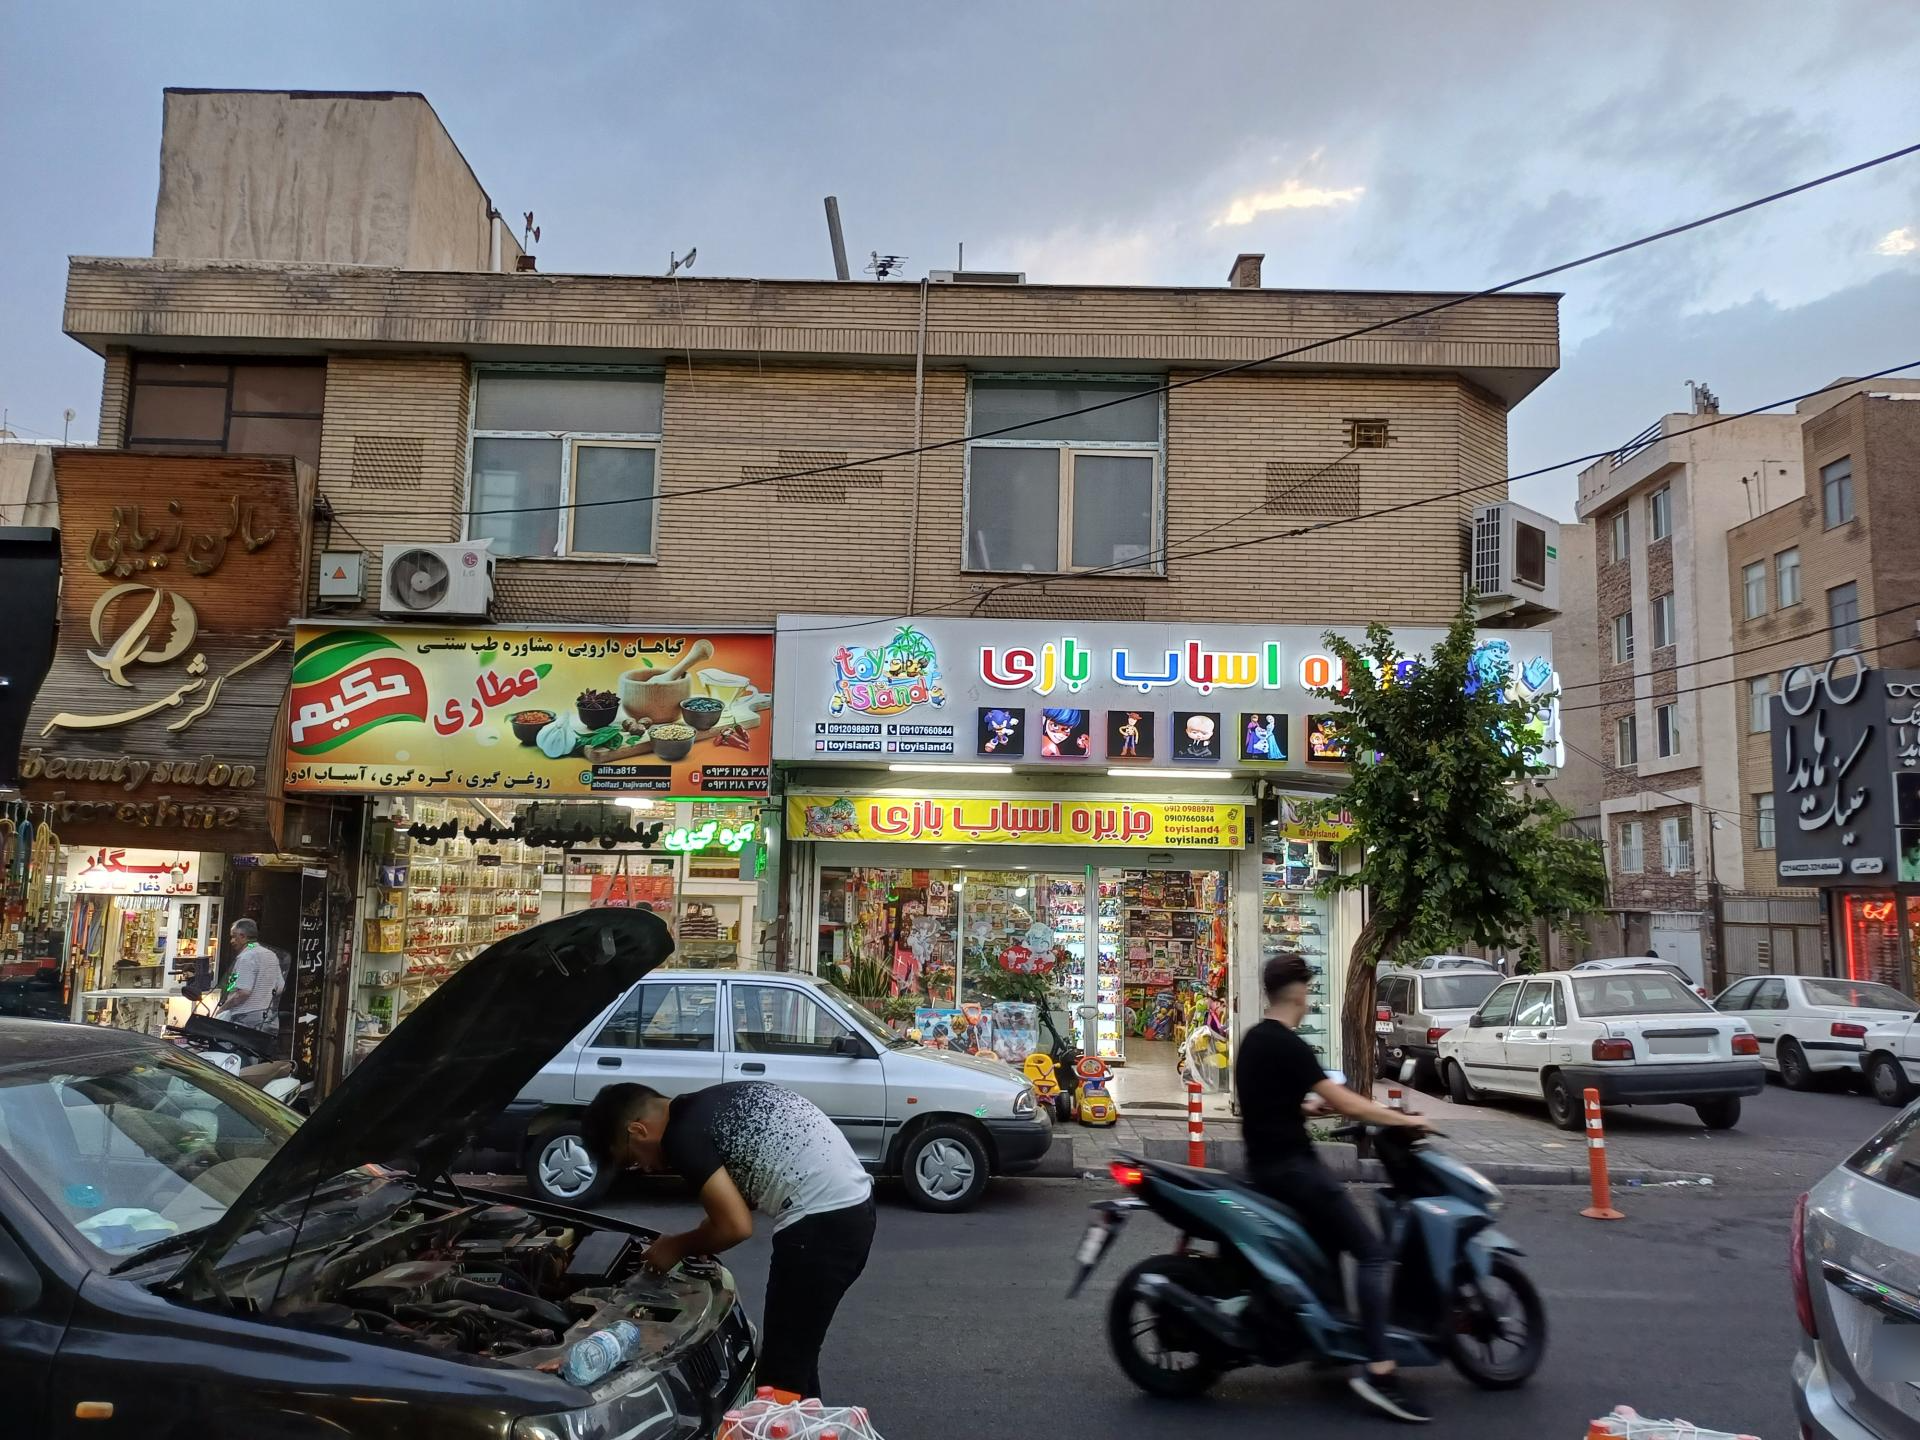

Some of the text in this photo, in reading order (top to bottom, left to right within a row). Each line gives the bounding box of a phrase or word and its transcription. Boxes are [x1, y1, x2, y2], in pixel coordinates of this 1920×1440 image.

[85, 494, 276, 578] سالن زیبایی
[417, 637, 467, 654] سنتی
[471, 636, 498, 655] طب
[503, 637, 553, 656] مشاوره
[624, 638, 685, 658] گیاهان
[834, 647, 886, 681] toy
[980, 637, 1092, 697] بازی
[1112, 639, 1281, 696] اسباب
[841, 677, 929, 710] island
[289, 664, 541, 744] عطاری حکیم
[829, 724, 879, 733] 09120988978
[900, 726, 952, 735] 09107660844
[828, 741, 880, 752] toyisland3
[900, 741, 952, 752] toyisland4
[20, 748, 256, 791] beauty salon
[314, 765, 367, 782] آسیاب
[417, 769, 453, 787] کره
[597, 766, 637, 775] alih.a815
[733, 767, 749, 776] ۱۲۵
[503, 771, 551, 789] روغن
[729, 780, 746, 790] ۲۱۸
[1164, 805, 1181, 813] 0912
[869, 799, 1153, 842] جزیره اسباب بازی
[1165, 814, 1215, 823] 09107660844
[1165, 824, 1220, 835] toyisland4
[1306, 829, 1340, 839] toyisland4
[1166, 835, 1219, 846] toyisland3
[79, 848, 190, 879] سیگار
[133, 882, 161, 893] ذغال
[166, 882, 194, 893] قلیان
